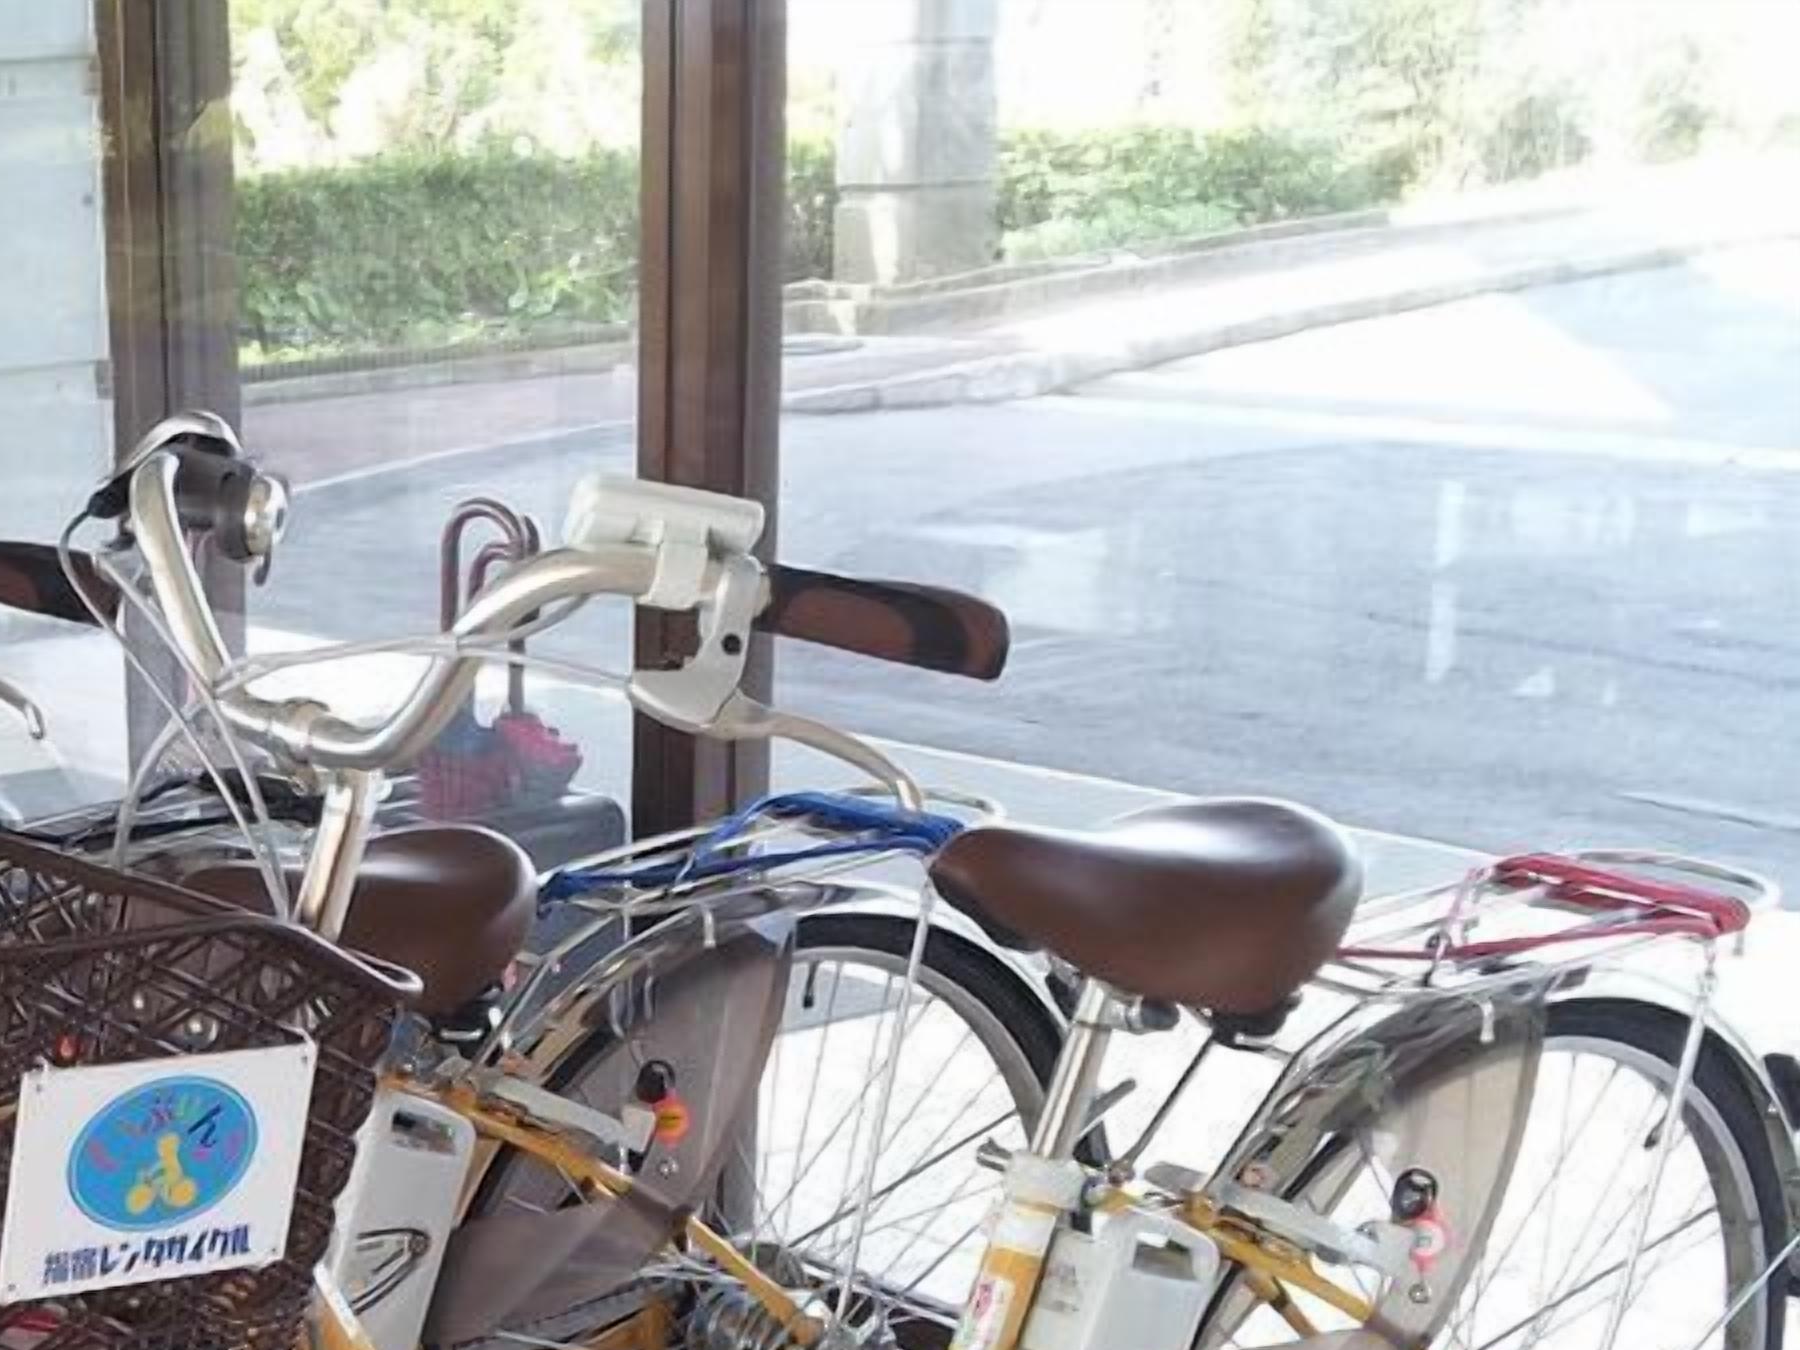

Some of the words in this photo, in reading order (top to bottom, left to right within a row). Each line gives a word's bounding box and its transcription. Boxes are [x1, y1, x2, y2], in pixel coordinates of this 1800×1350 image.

[43, 1223, 251, 1288] 指宿レンタサイクル
